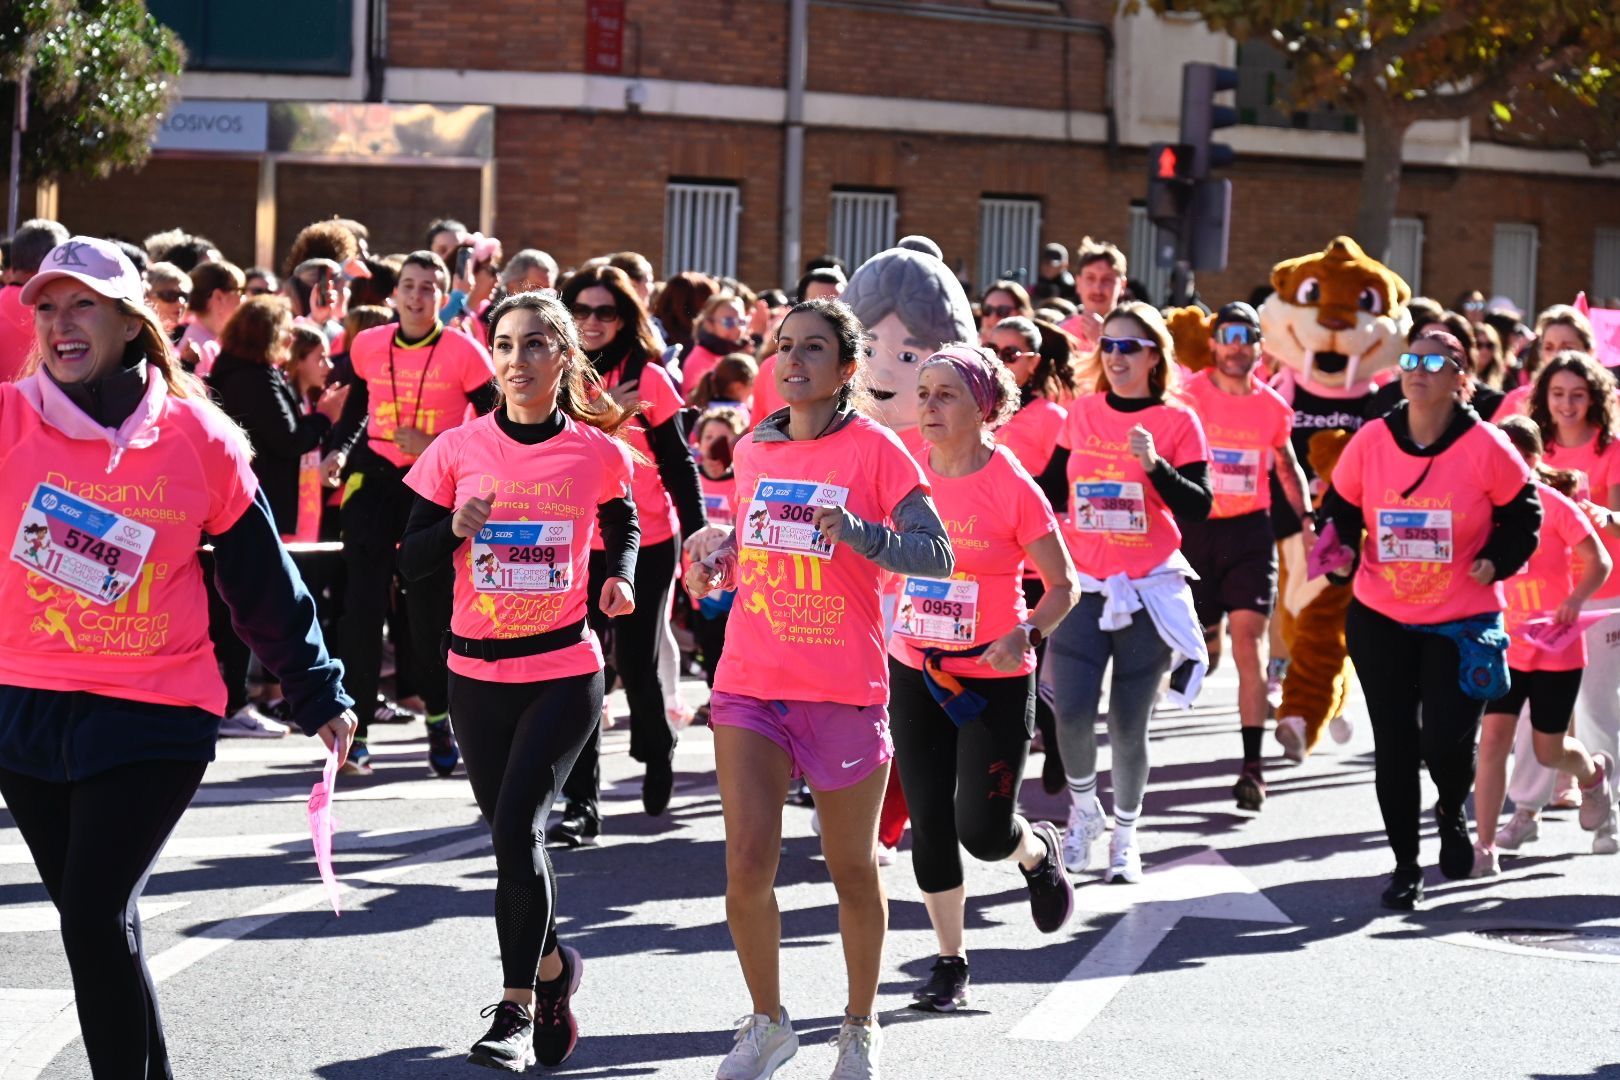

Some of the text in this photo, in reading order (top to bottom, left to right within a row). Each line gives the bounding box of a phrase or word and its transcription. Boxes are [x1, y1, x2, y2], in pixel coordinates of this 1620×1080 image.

[479, 474, 576, 499] Drasanvi
[122, 507, 186, 521] CAROBELS
[537, 501, 585, 516] CAROBELS
[1405, 528, 1438, 540] 5753
[64, 528, 121, 566] 5748
[951, 537, 990, 548] AROBELS
[509, 547, 555, 562] 2499
[772, 589, 845, 610] Carrera
[923, 599, 962, 617] 0953
[79, 609, 169, 632] Carrera
[512, 609, 561, 623] Mujer
[791, 608, 844, 626] Mujer
[789, 625, 822, 635] almom
[103, 629, 168, 652] Mujer
[779, 634, 845, 646] DRASANVI
